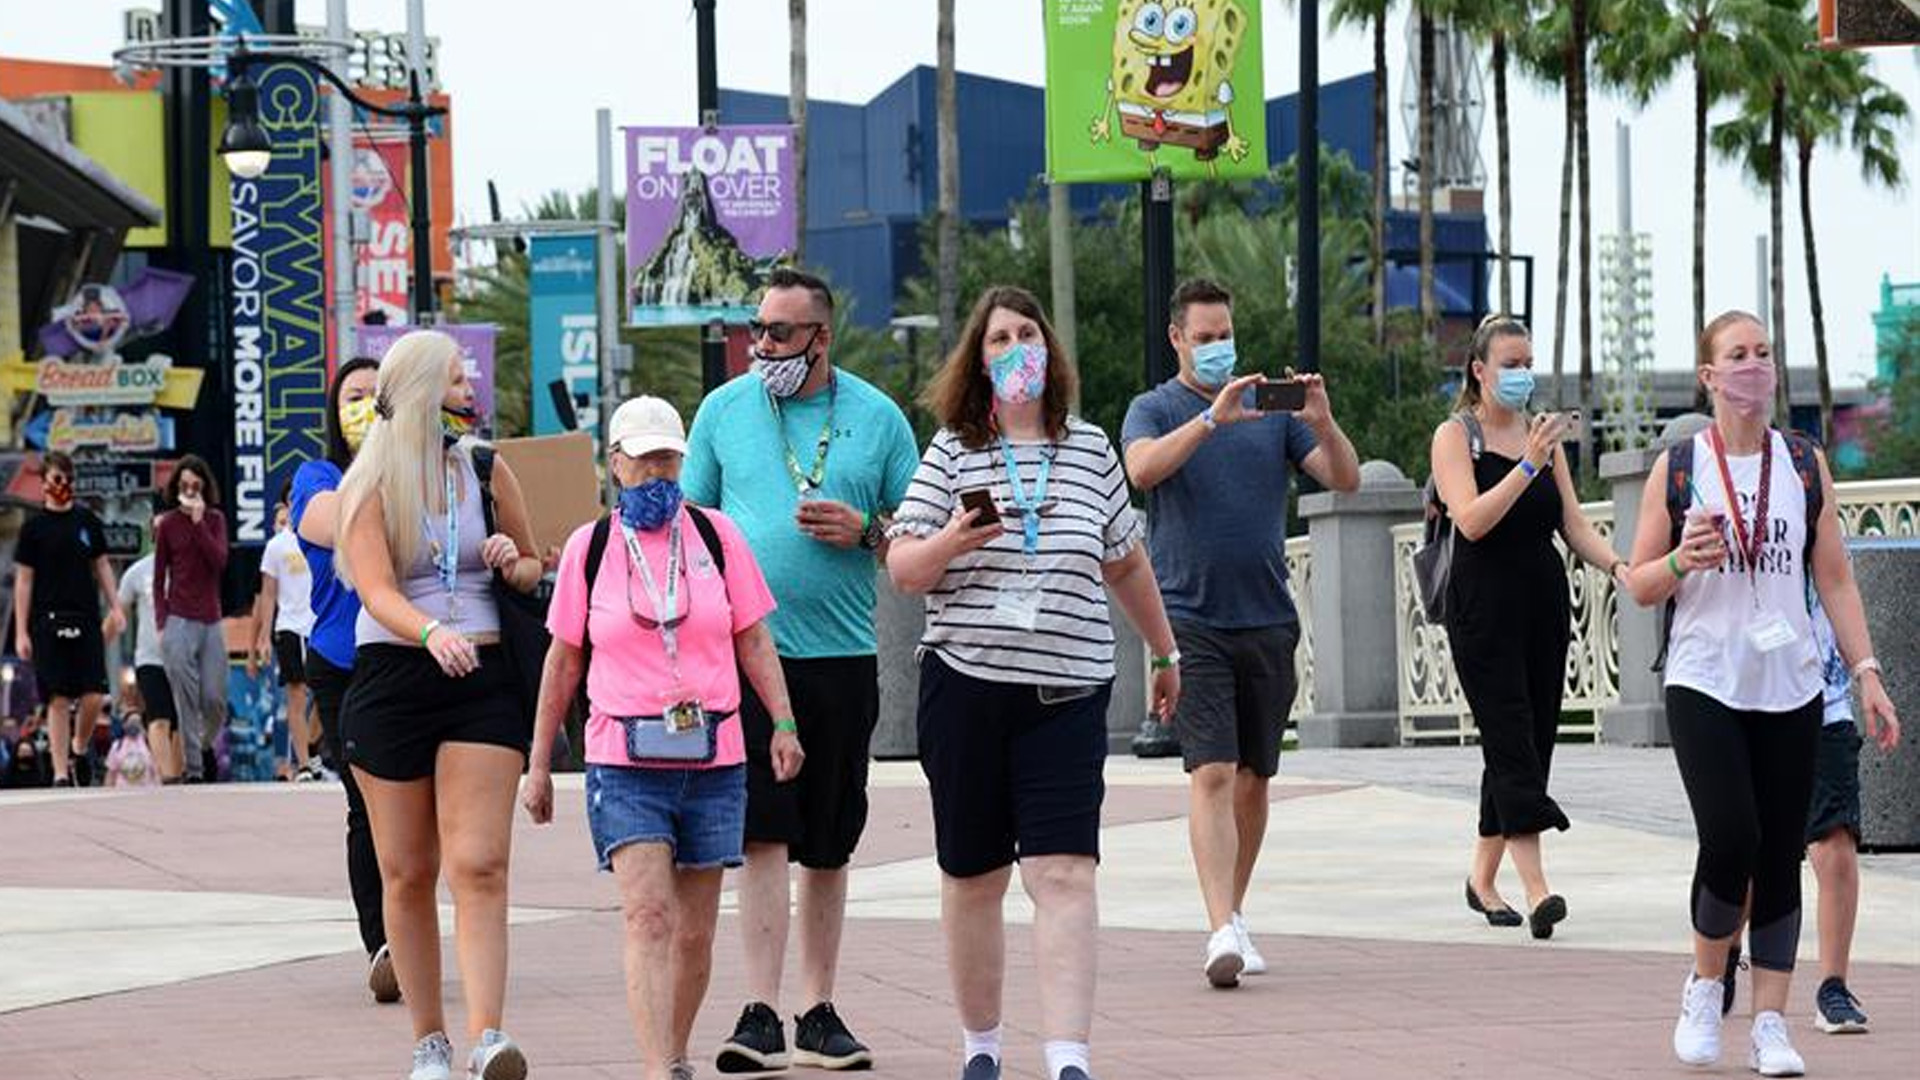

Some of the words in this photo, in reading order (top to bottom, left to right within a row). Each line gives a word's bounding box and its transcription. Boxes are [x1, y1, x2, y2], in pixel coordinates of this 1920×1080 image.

[636, 136, 787, 175] FLOAT
[637, 177, 678, 199] ON
[709, 176, 782, 199] OVER
[231, 182, 260, 316] SAVOR
[257, 61, 327, 472] CITYWALK
[117, 368, 163, 387] BOX
[234, 326, 264, 447] MORE
[236, 456, 265, 542] FUN
